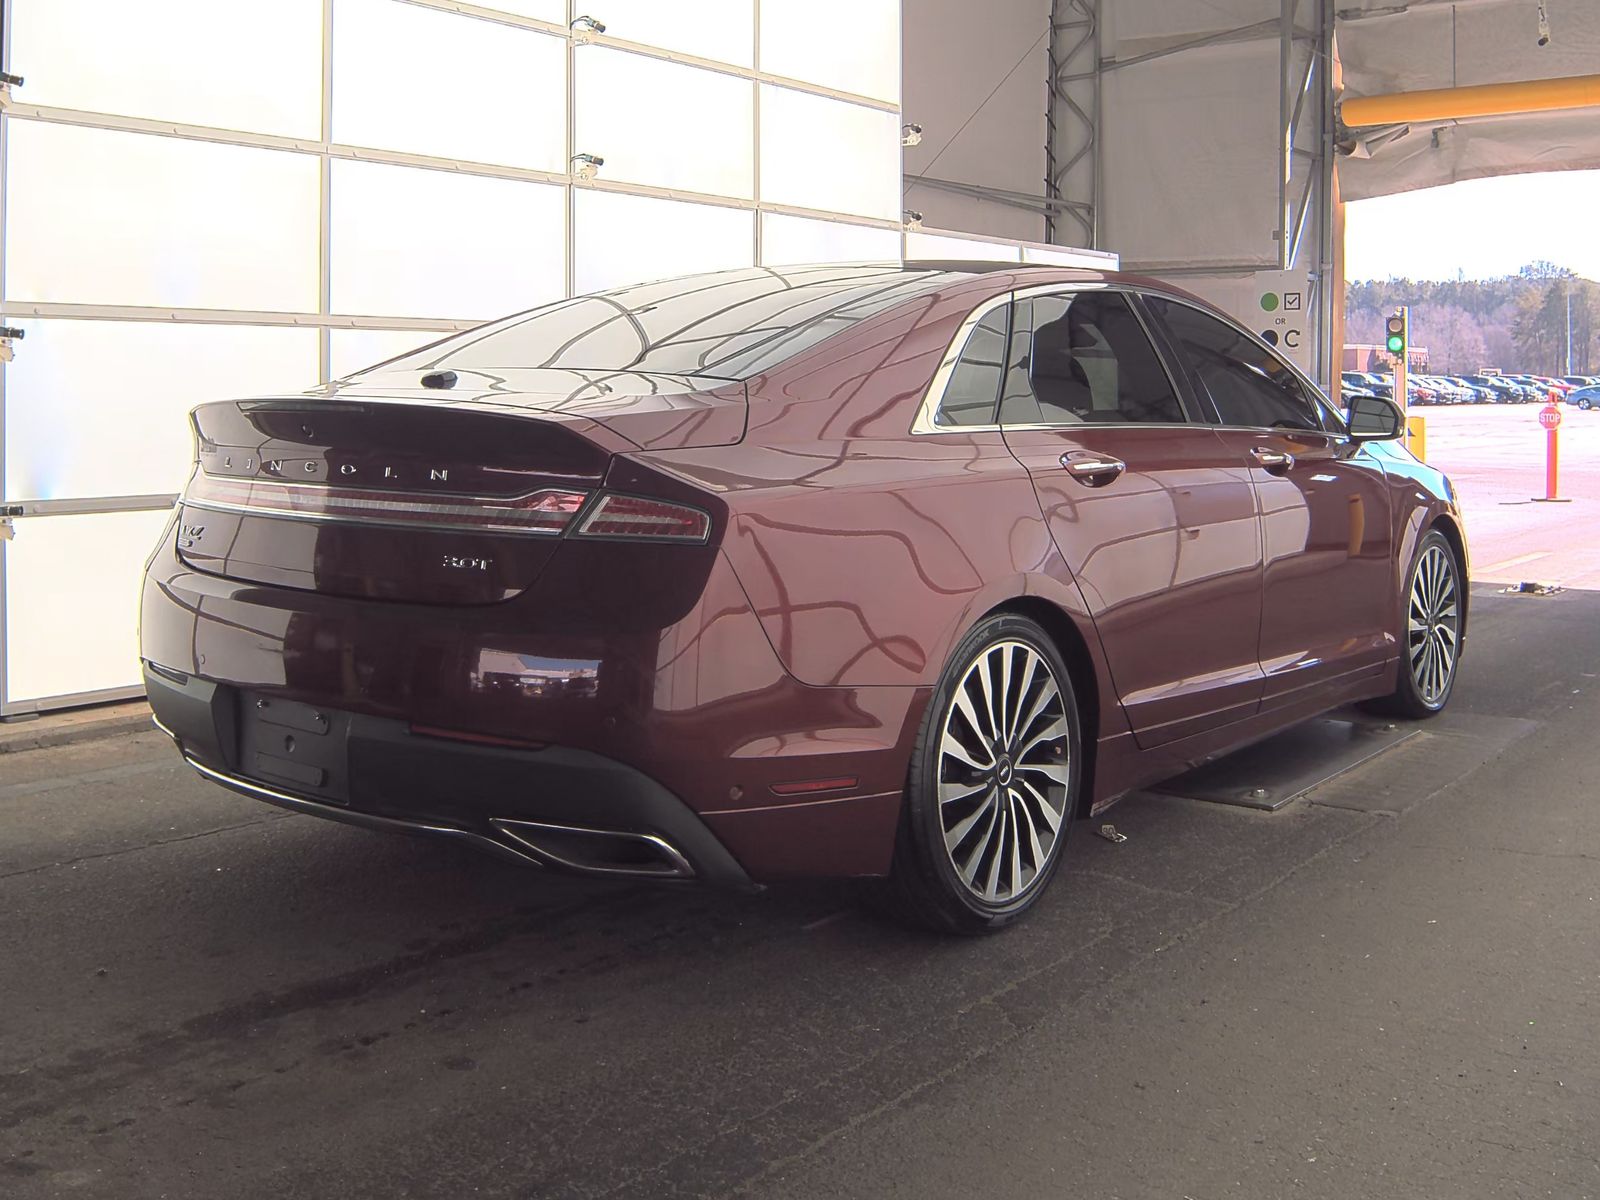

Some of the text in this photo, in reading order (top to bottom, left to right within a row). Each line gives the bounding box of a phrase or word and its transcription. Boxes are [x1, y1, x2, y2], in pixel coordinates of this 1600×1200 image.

[1274, 317, 1287, 325] OR
[1539, 413, 1560, 422] STOP
[223, 455, 449, 482] LINCOLN
